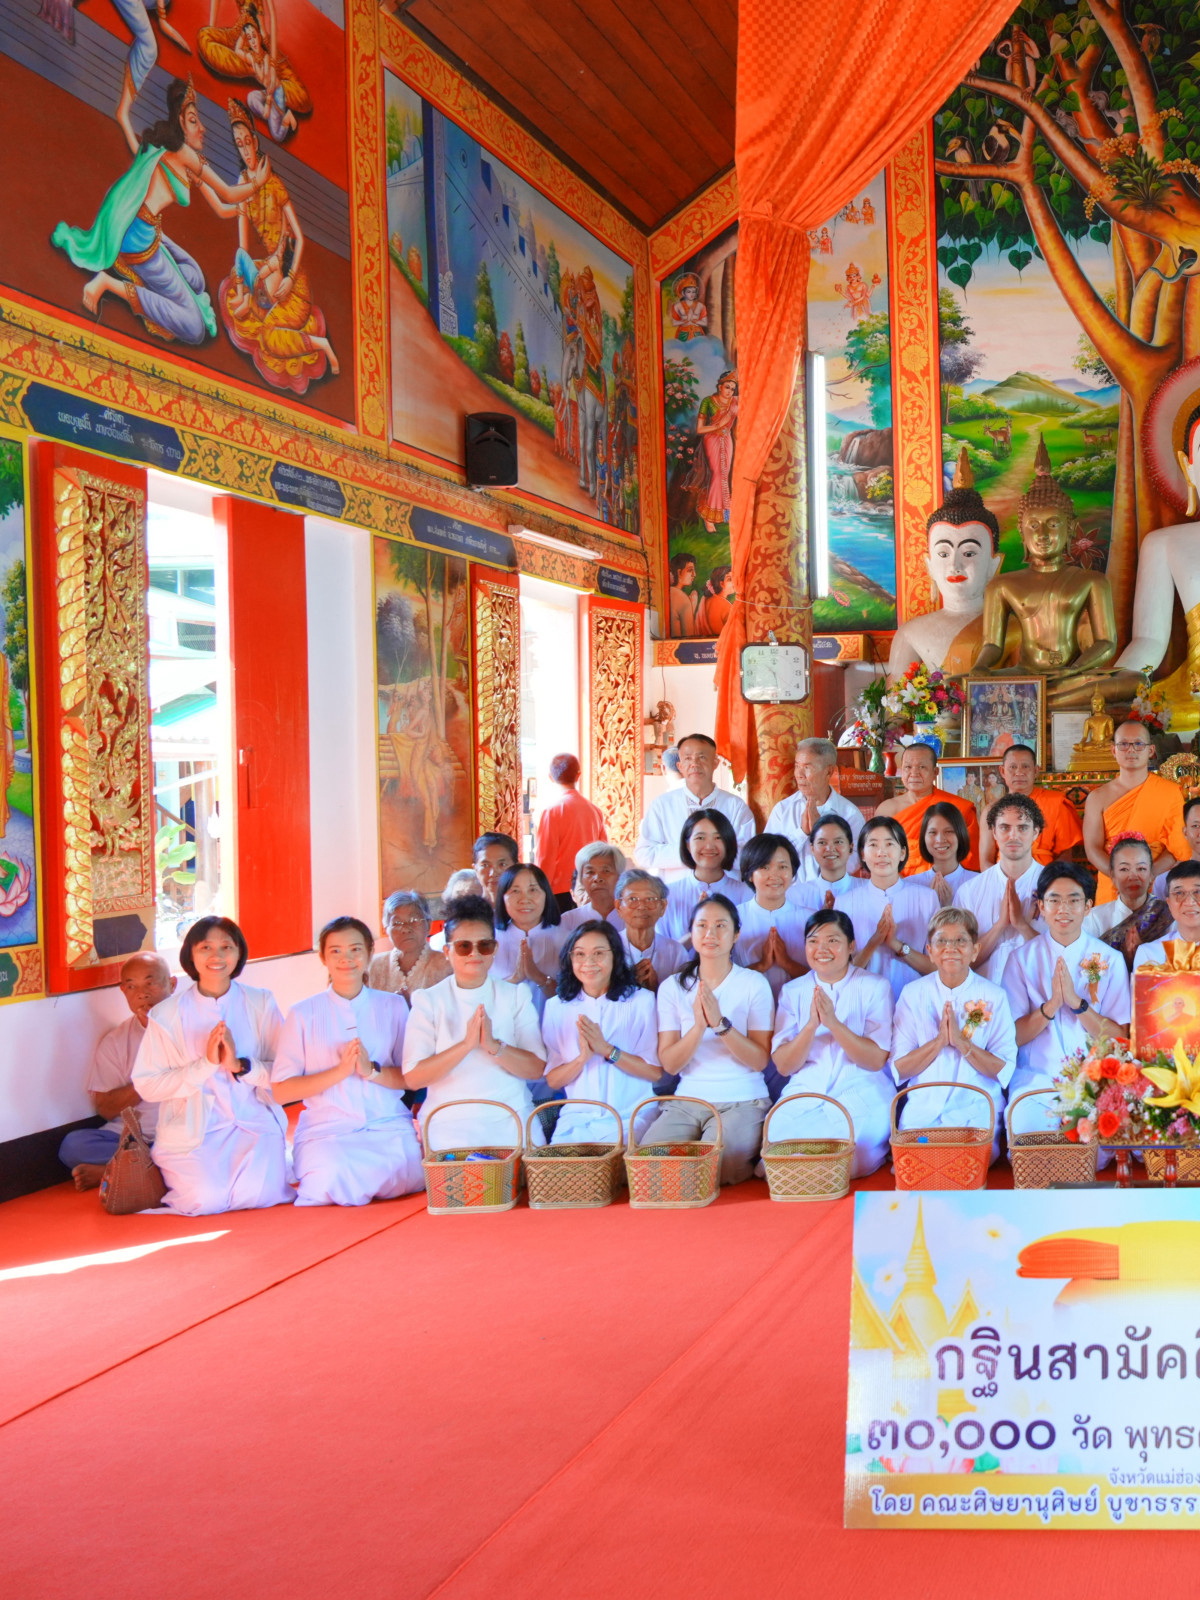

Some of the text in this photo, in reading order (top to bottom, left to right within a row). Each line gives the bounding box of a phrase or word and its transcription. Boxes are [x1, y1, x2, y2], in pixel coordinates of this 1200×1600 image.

[867, 1419, 1057, 1458] ๓๐,๐๐๐
[1072, 1414, 1113, 1450] วัด
[871, 1488, 912, 1512] โดย
[922, 1488, 1098, 1520] คณะศิษยานุศิษย์
